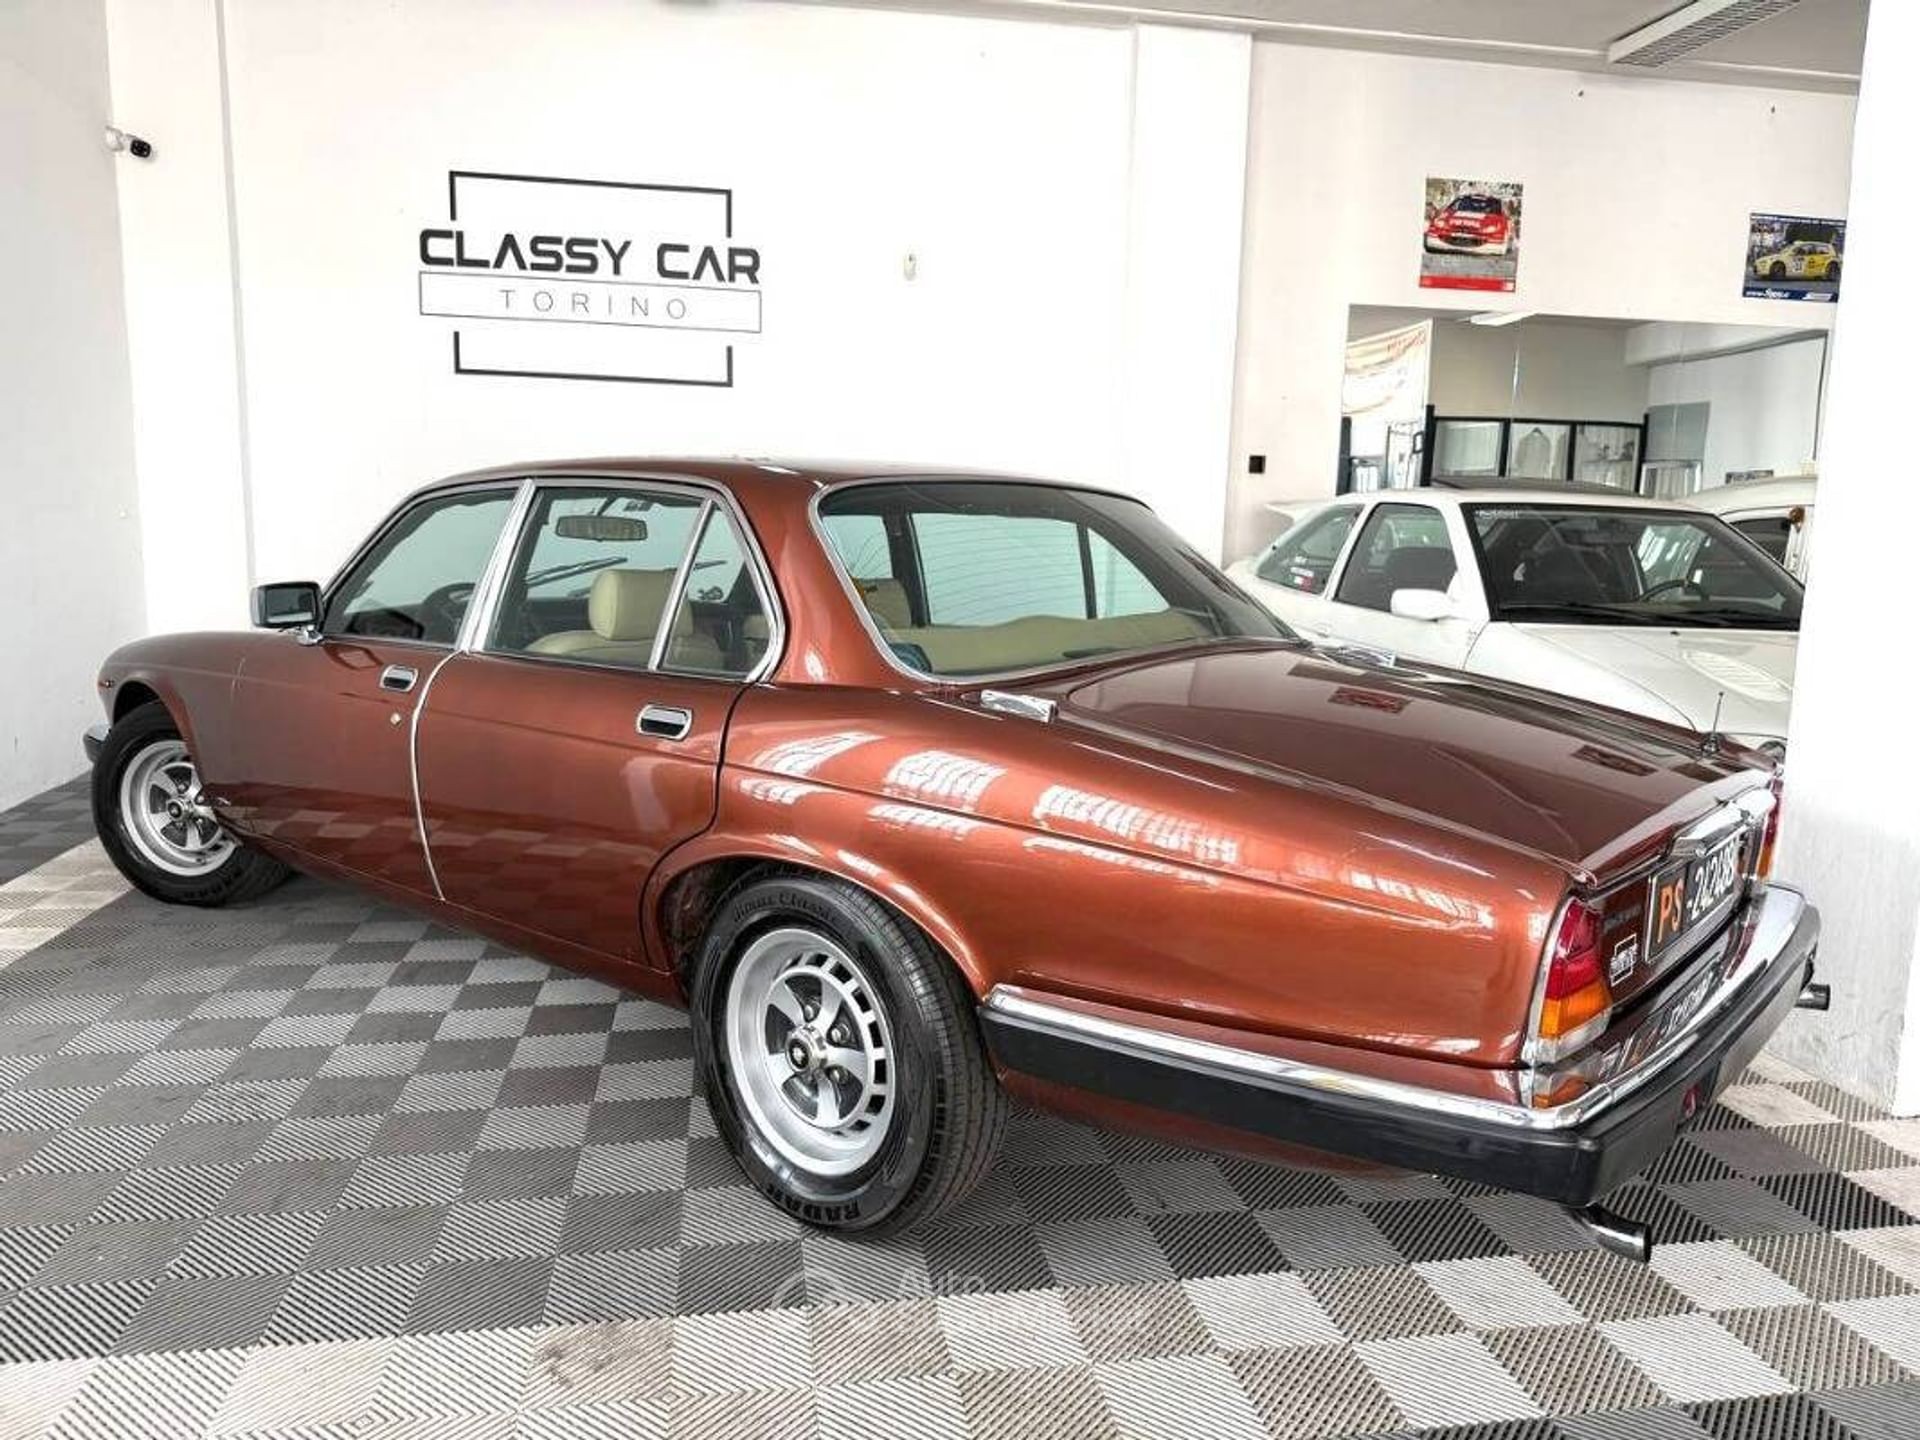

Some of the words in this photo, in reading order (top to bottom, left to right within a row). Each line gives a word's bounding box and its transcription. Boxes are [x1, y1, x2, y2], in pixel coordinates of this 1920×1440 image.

[419, 228, 632, 276] CLASSY
[656, 242, 761, 284] CAR
[499, 288, 687, 320] TORINO
